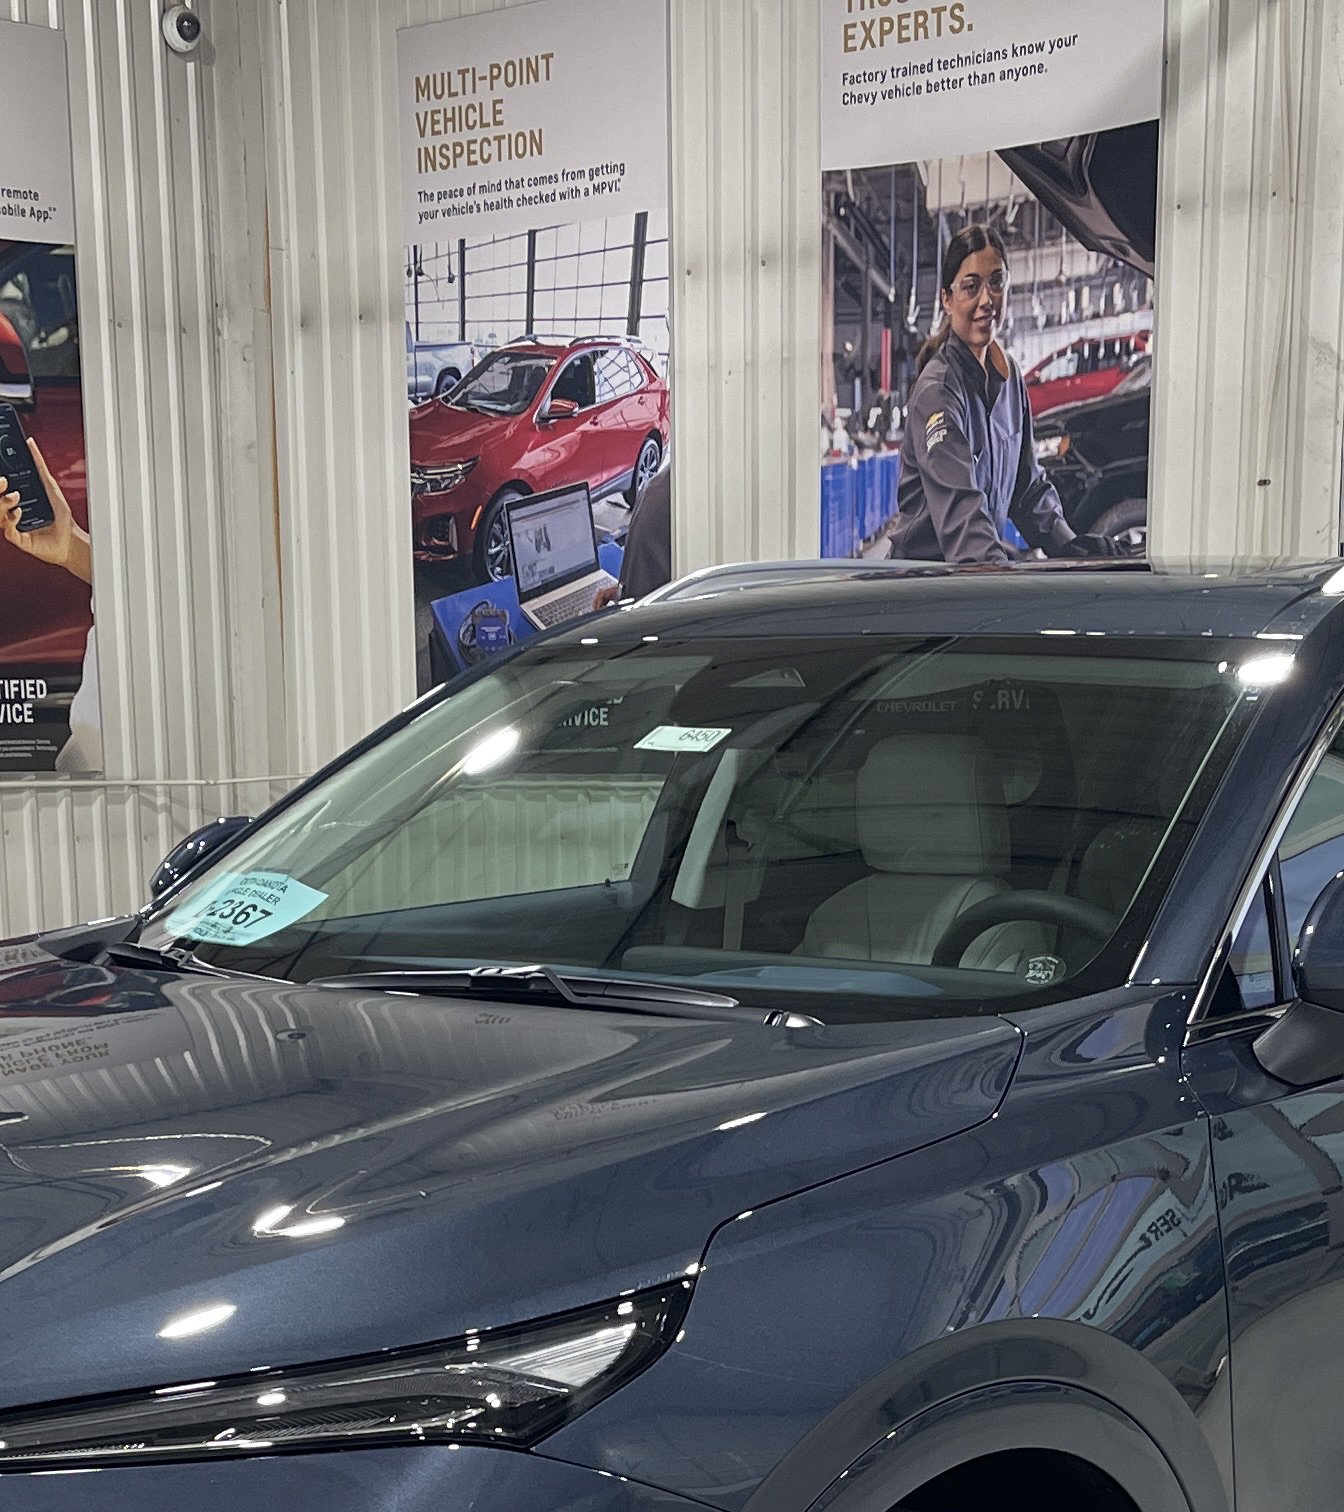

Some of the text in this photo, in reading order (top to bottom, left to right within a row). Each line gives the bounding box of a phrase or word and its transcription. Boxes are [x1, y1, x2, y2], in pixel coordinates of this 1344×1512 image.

[843, 2, 974, 53] EXPERTS.
[414, 52, 555, 104] MULTI-POINT
[842, 33, 1079, 87] Factory trained technicians know your
[842, 61, 1049, 106] Chevy vehicle better than anyone.
[415, 98, 505, 139] VEHICLE
[416, 128, 543, 174] INSPECTION
[1, 187, 40, 201] remote
[417, 161, 626, 204] The peace of mind that comes from getting
[417, 208, 440, 225] your
[441, 199, 481, 219] vehicle's
[483, 196, 514, 213] health
[515, 190, 557, 208] checked
[558, 185, 582, 201] with
[583, 187, 590, 198] a
